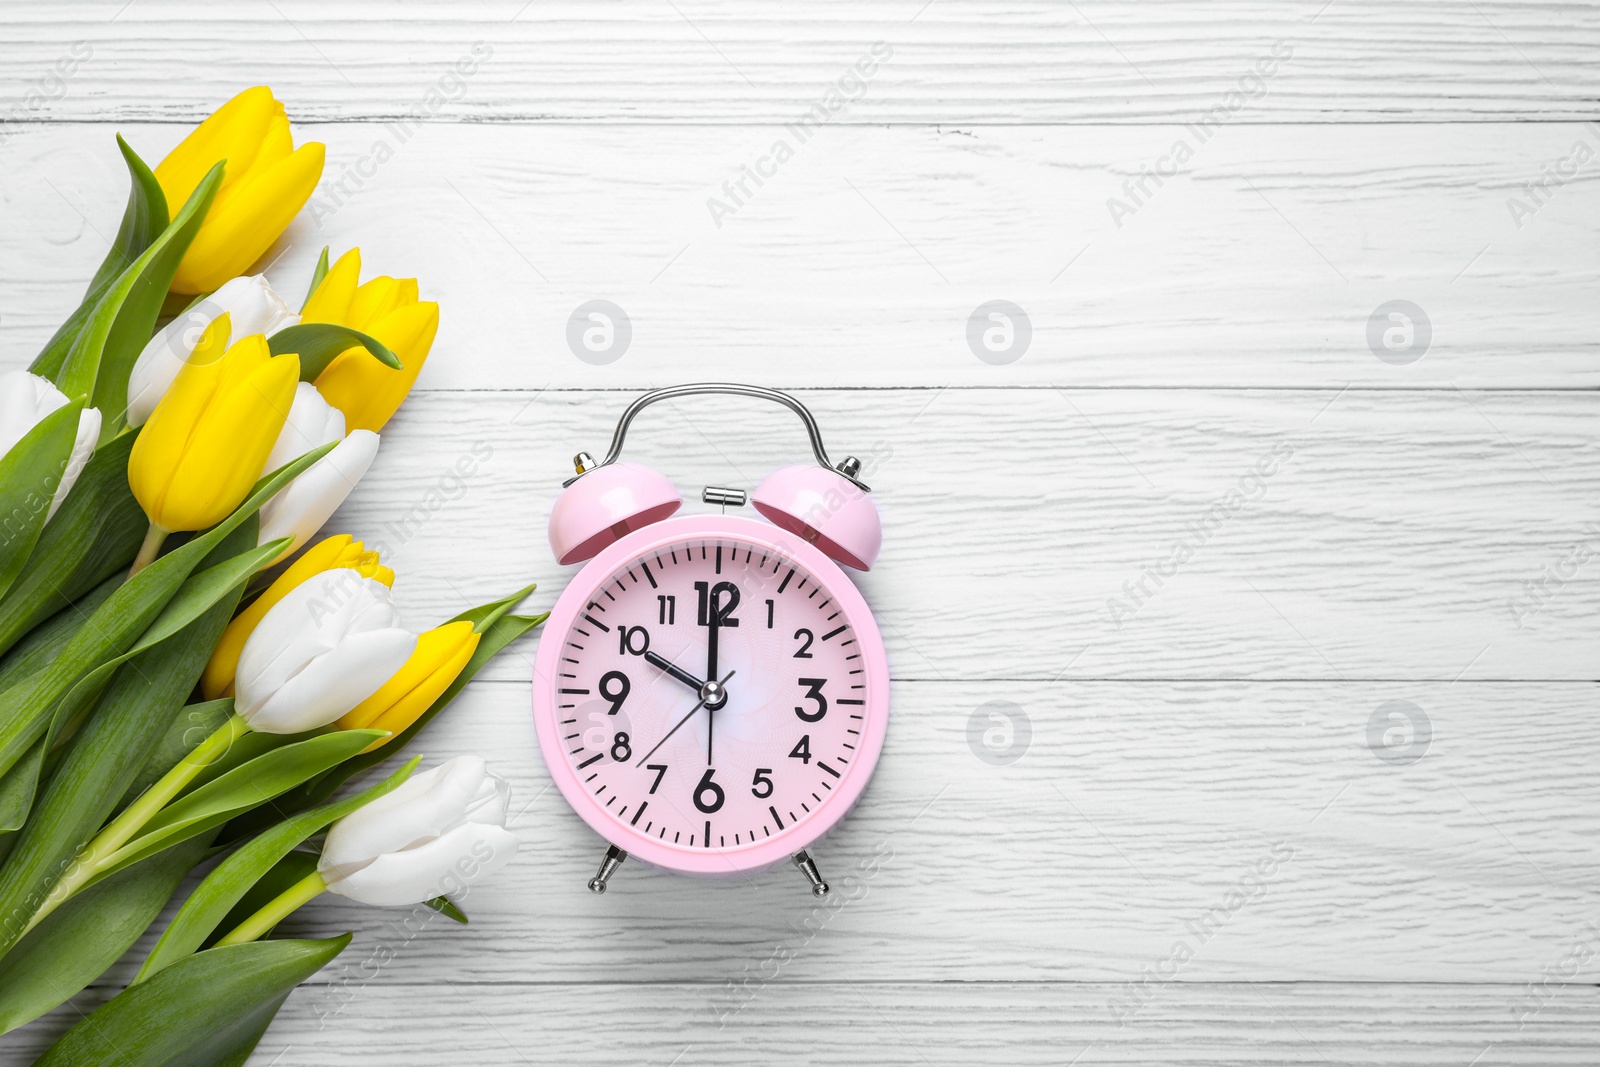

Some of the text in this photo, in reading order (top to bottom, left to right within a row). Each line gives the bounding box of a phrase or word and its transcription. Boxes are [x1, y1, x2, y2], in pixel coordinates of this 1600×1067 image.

[658, 595, 676, 625] 11
[694, 582, 740, 627] 12
[766, 600, 775, 628] 1
[618, 626, 651, 656] 10
[793, 629, 814, 658] 2
[599, 671, 631, 716] 9
[795, 678, 828, 723] 3
[611, 732, 632, 763] 8
[788, 735, 812, 764] 4
[647, 765, 669, 795] 7
[693, 769, 725, 814] 6
[752, 769, 773, 799] 5
